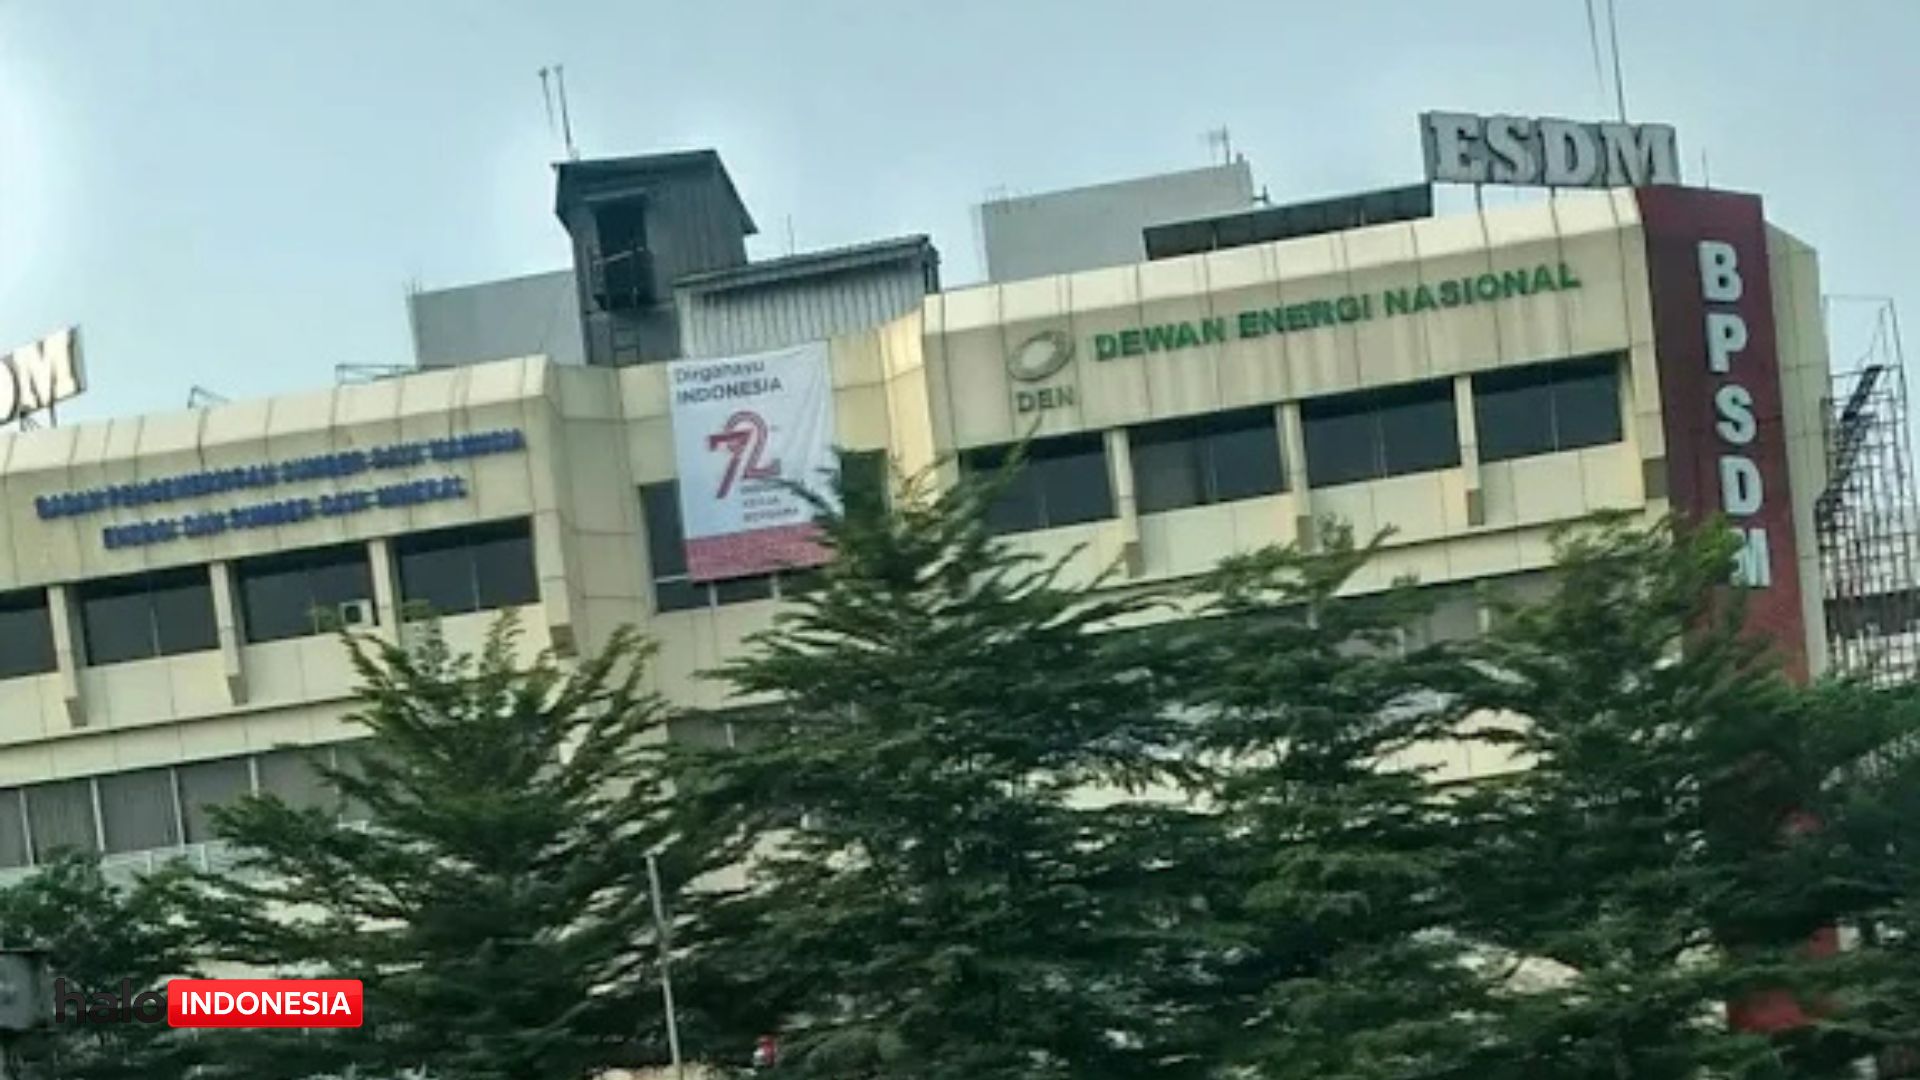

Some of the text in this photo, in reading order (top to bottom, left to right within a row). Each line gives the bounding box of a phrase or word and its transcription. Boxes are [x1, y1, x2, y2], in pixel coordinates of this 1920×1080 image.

[1424, 111, 1680, 186] ESDM
[1095, 262, 1581, 361] DEWAN ENERGI NASIONAL
[676, 377, 784, 404] INDONESIA
[1016, 385, 1074, 413] DEN
[1697, 240, 1772, 587] BPSDM
